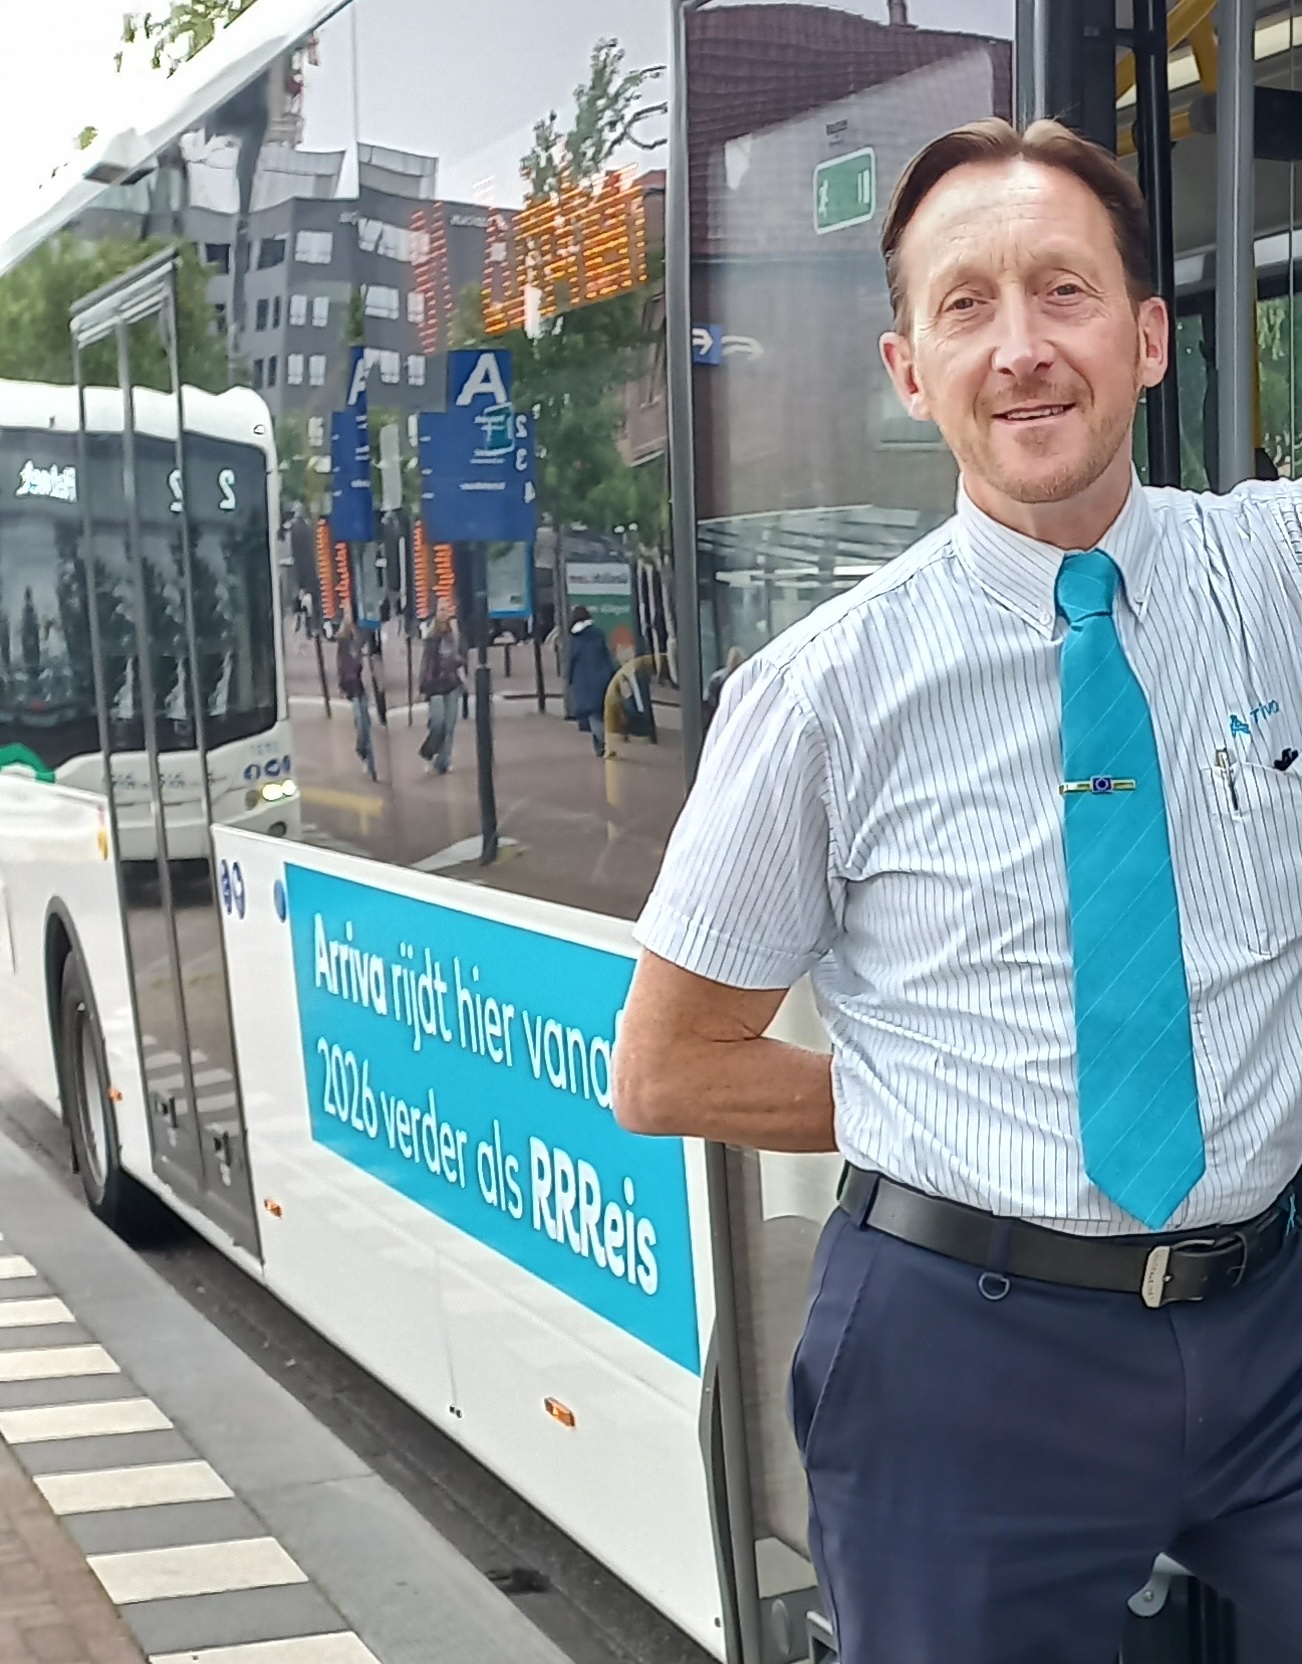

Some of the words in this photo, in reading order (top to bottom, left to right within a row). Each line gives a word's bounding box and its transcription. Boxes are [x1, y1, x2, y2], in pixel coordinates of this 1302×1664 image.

[315, 912, 387, 1016] Arriva
[391, 942, 452, 1051] rijdt
[453, 957, 514, 1067] hier
[522, 1008, 622, 1111] vana
[317, 1037, 379, 1139] 2026
[379, 1088, 467, 1189] verder
[477, 1119, 523, 1219] als
[529, 1136, 658, 1296] RRReis
